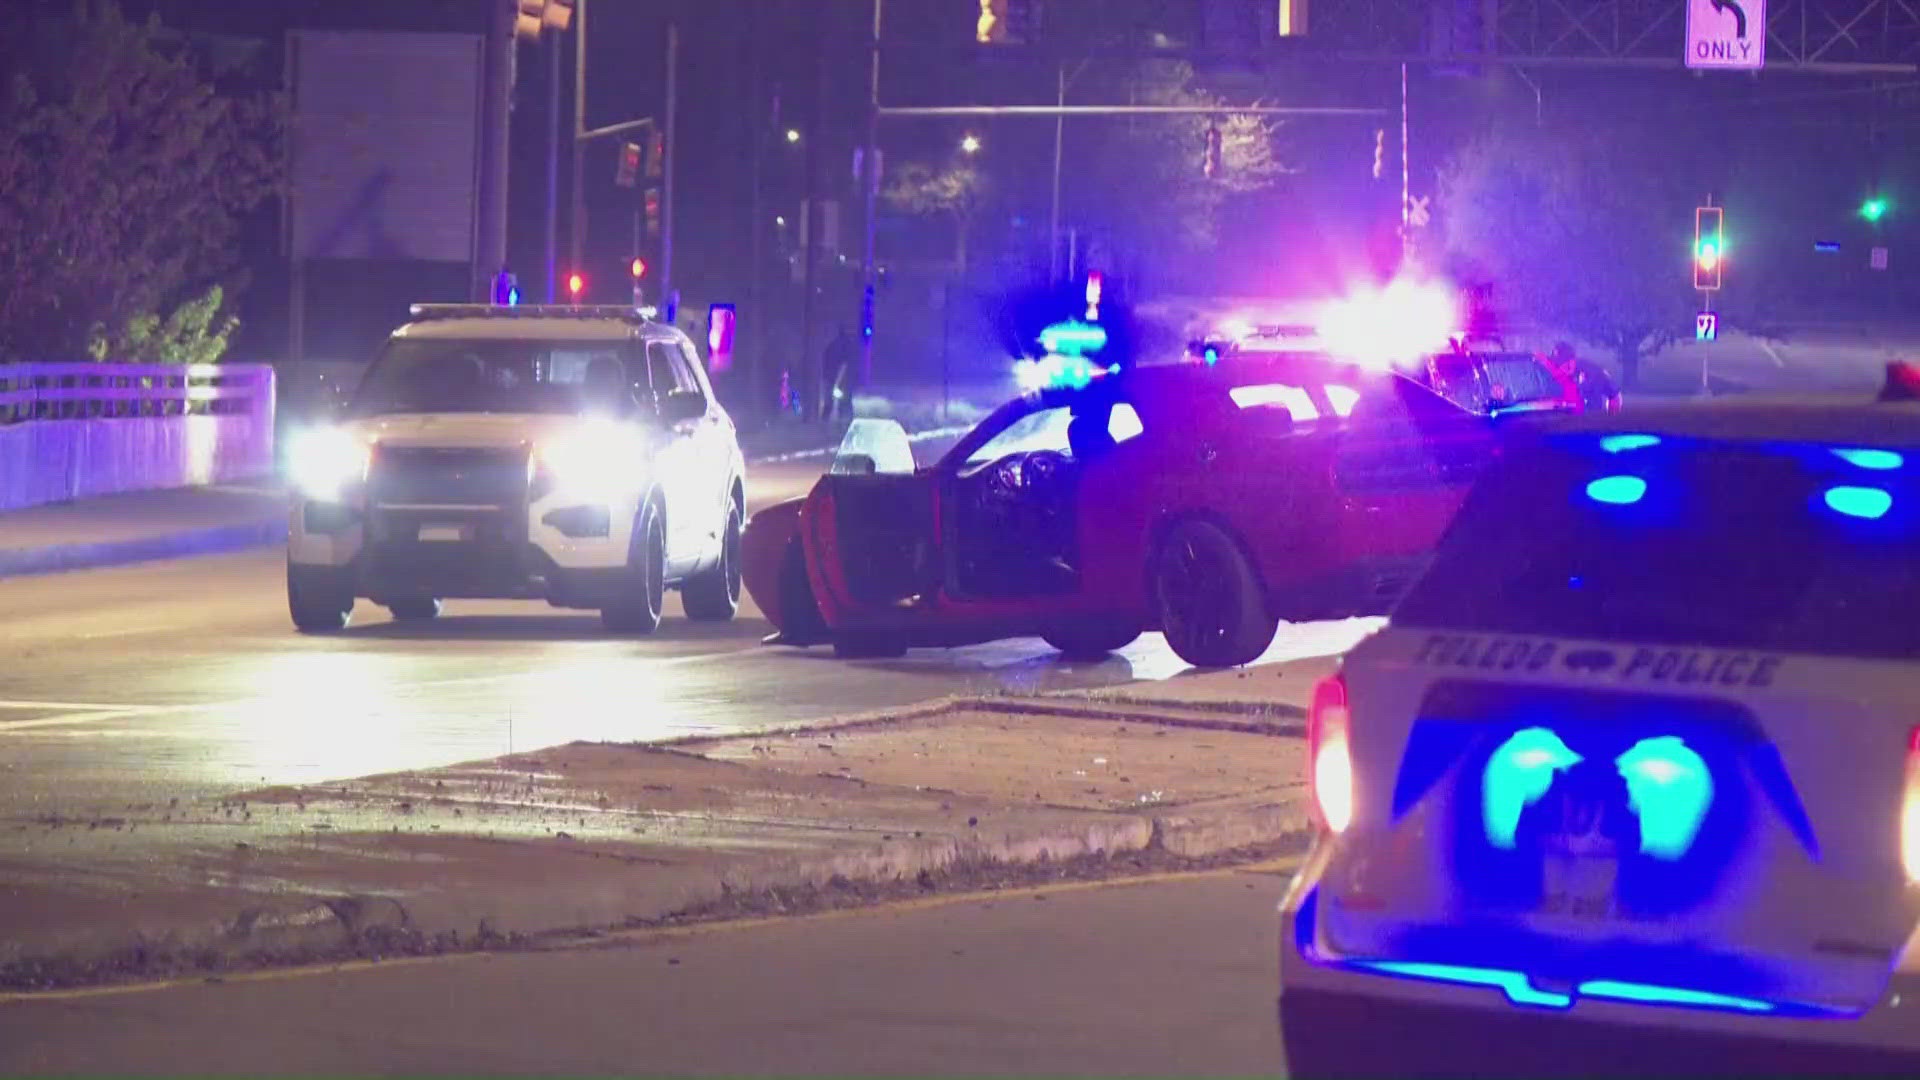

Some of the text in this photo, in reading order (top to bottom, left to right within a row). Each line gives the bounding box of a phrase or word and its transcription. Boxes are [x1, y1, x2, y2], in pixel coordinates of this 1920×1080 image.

[1697, 41, 1751, 59] ONLY
[1414, 635, 1783, 687] TOLEDO POLICE
